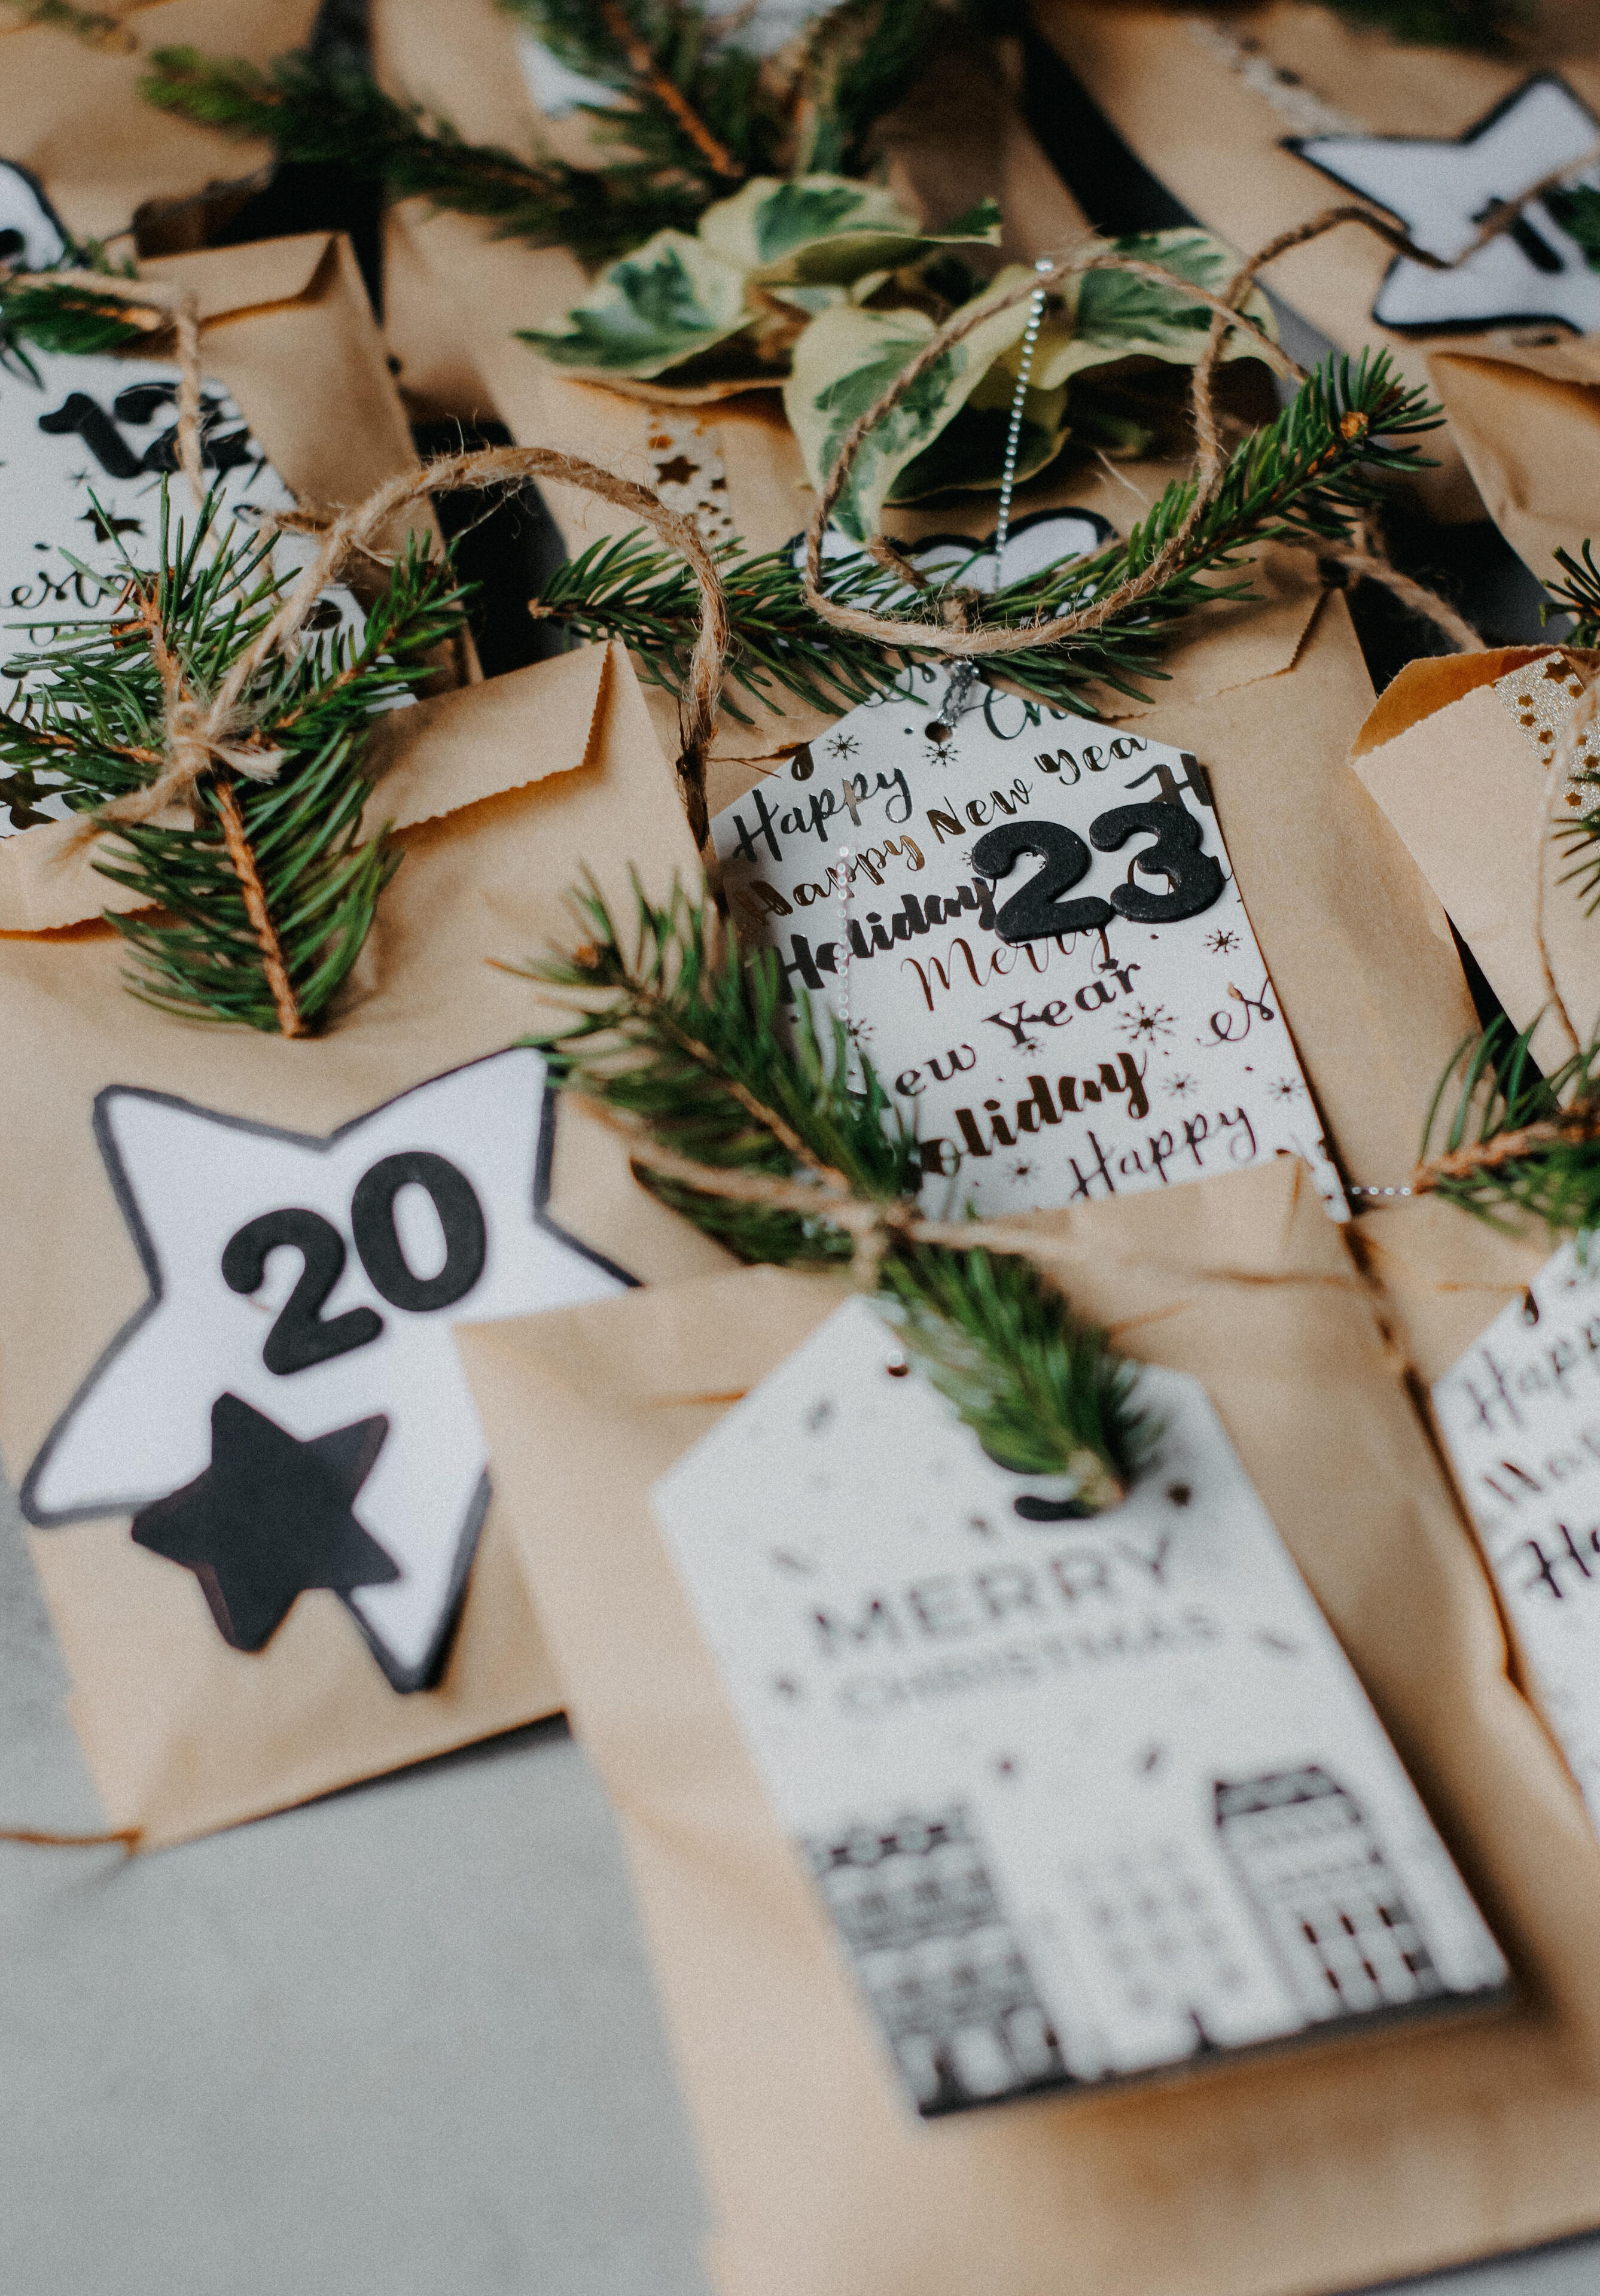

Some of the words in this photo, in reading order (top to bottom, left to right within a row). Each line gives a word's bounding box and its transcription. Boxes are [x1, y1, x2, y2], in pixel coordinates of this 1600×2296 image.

[38, 382, 255, 479] 12
[733, 768, 912, 863] Happy
[927, 779, 1033, 844] New
[971, 803, 1227, 943] 23
[775, 877, 998, 1004] Holiday
[895, 1043, 977, 1097] ew
[981, 960, 1141, 1047] Year
[914, 1052, 1148, 1180] oliday
[1069, 1106, 1256, 1198] Happy
[221, 1150, 487, 1376] 20
[811, 1530, 1176, 1656] MERRY
